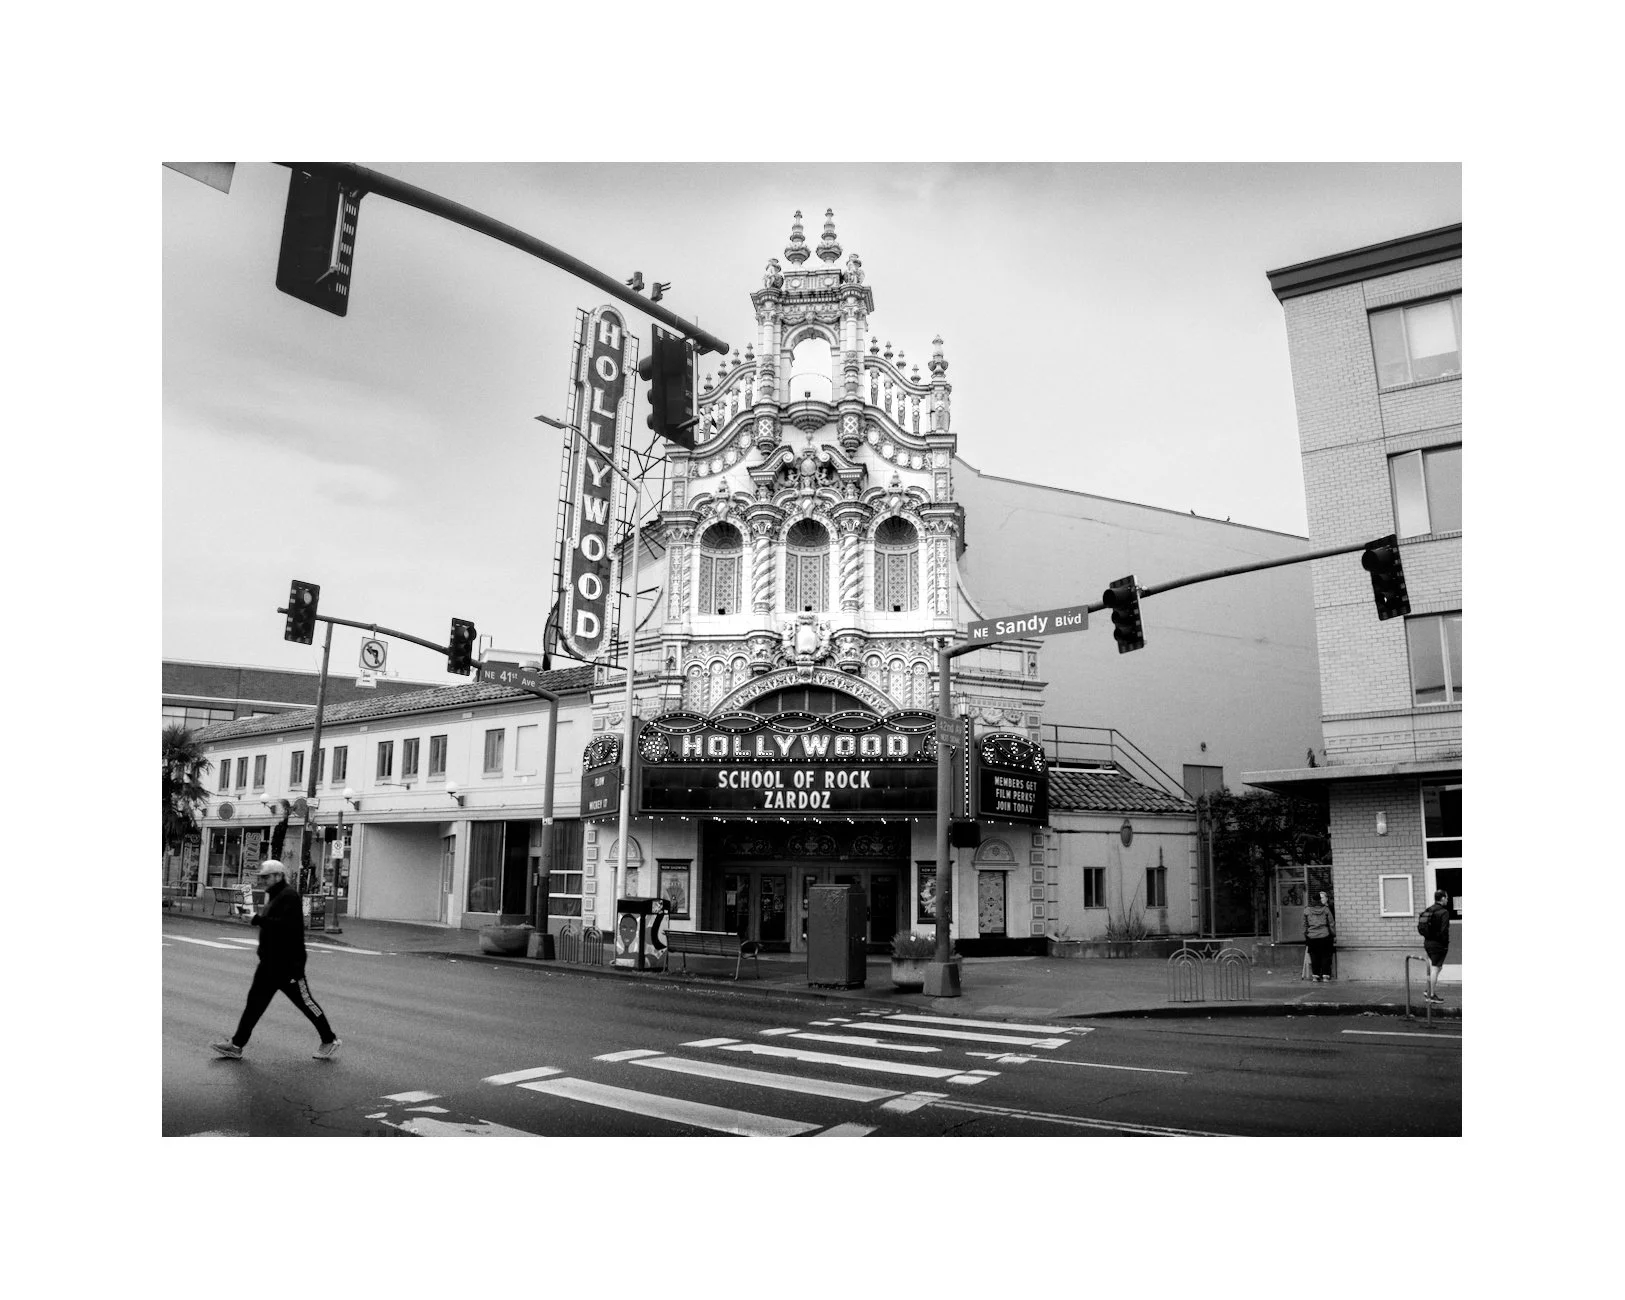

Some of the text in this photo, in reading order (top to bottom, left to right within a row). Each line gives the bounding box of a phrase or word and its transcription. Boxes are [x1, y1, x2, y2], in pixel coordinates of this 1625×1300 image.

[574, 317, 622, 640] HOLLYWOOD
[973, 614, 1082, 638] NE Sandy Blvd
[484, 670, 536, 688] NE 41st Ave
[682, 734, 909, 758] HOLLYWOOD
[718, 770, 871, 789] SCHOOL OF ROCK
[994, 775, 1037, 791] MEMBERS GET
[764, 790, 831, 809] ZARDOZ
[995, 788, 1036, 803] FILM PERKS!
[995, 800, 1033, 814] JOIN TODAY
